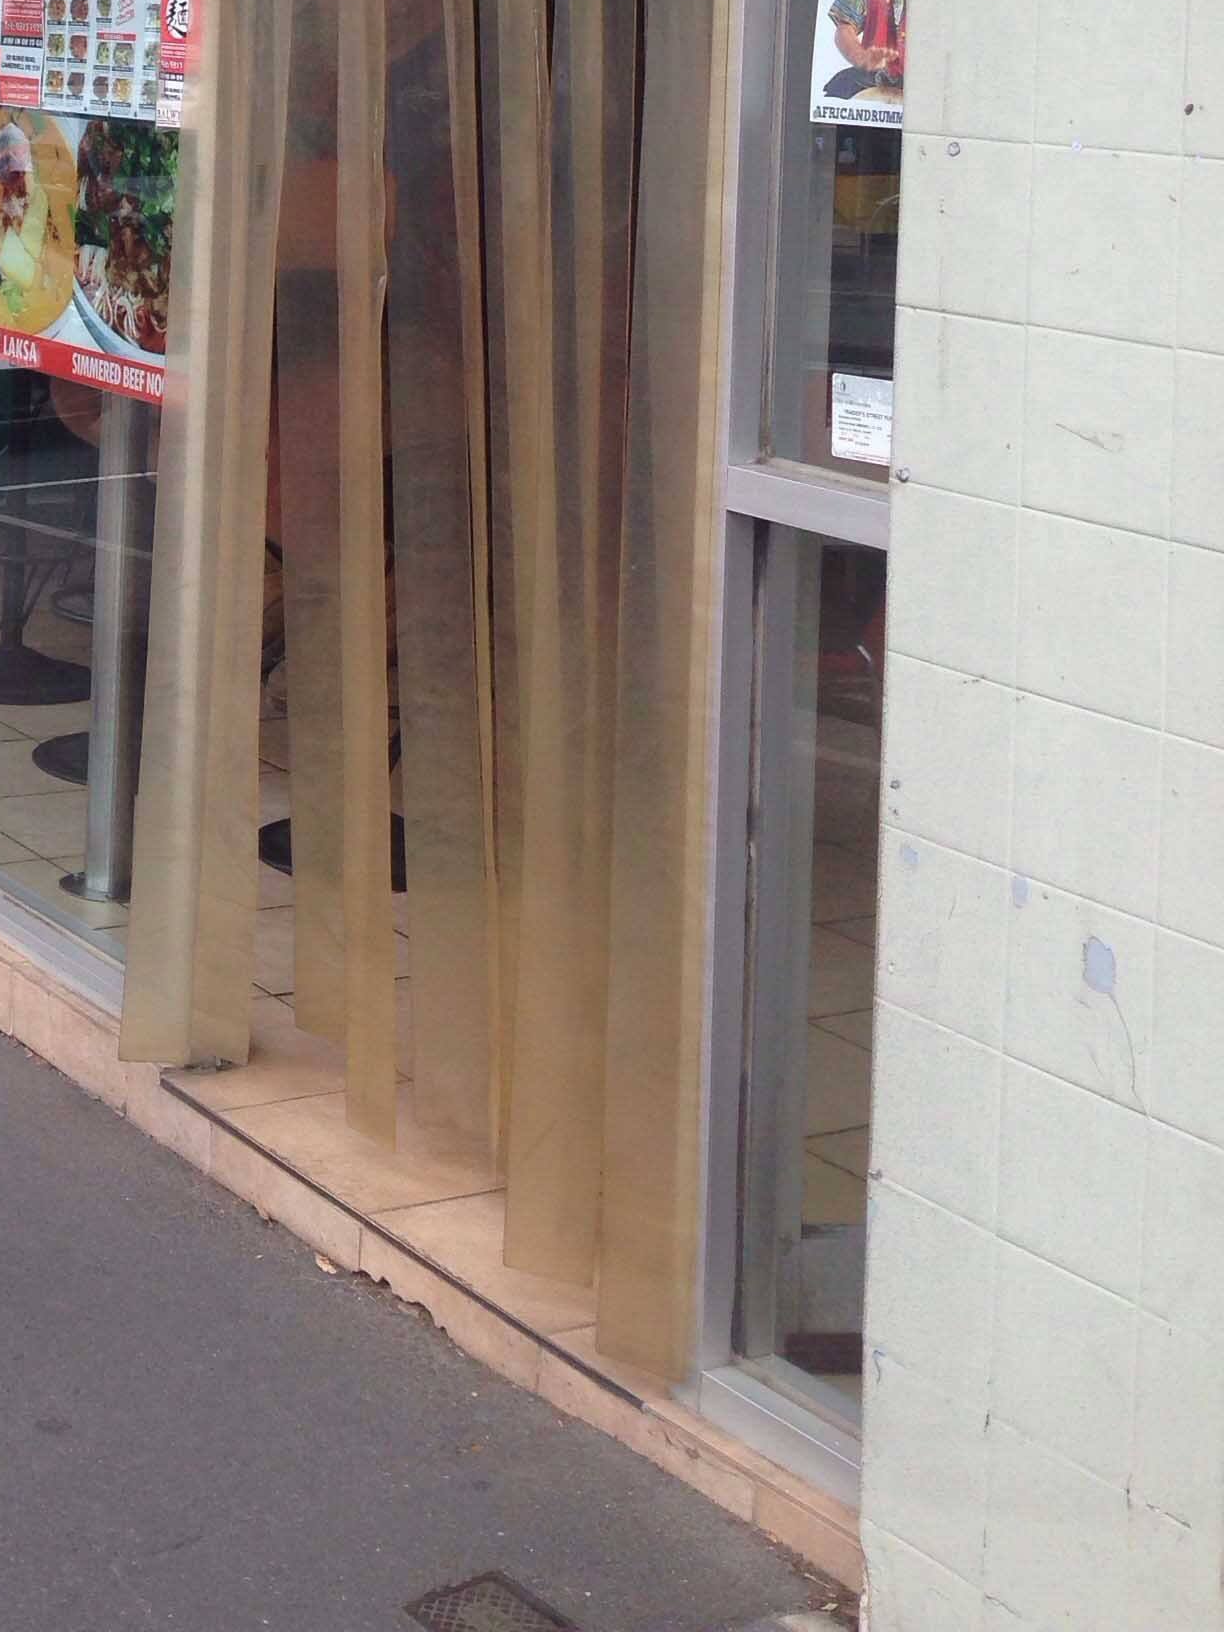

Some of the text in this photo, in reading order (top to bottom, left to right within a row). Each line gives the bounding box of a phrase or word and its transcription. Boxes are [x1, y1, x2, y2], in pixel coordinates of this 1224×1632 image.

[3, 334, 38, 363] LAKSA
[71, 352, 122, 386] SIMMERED
[122, 365, 145, 393] BEEF
